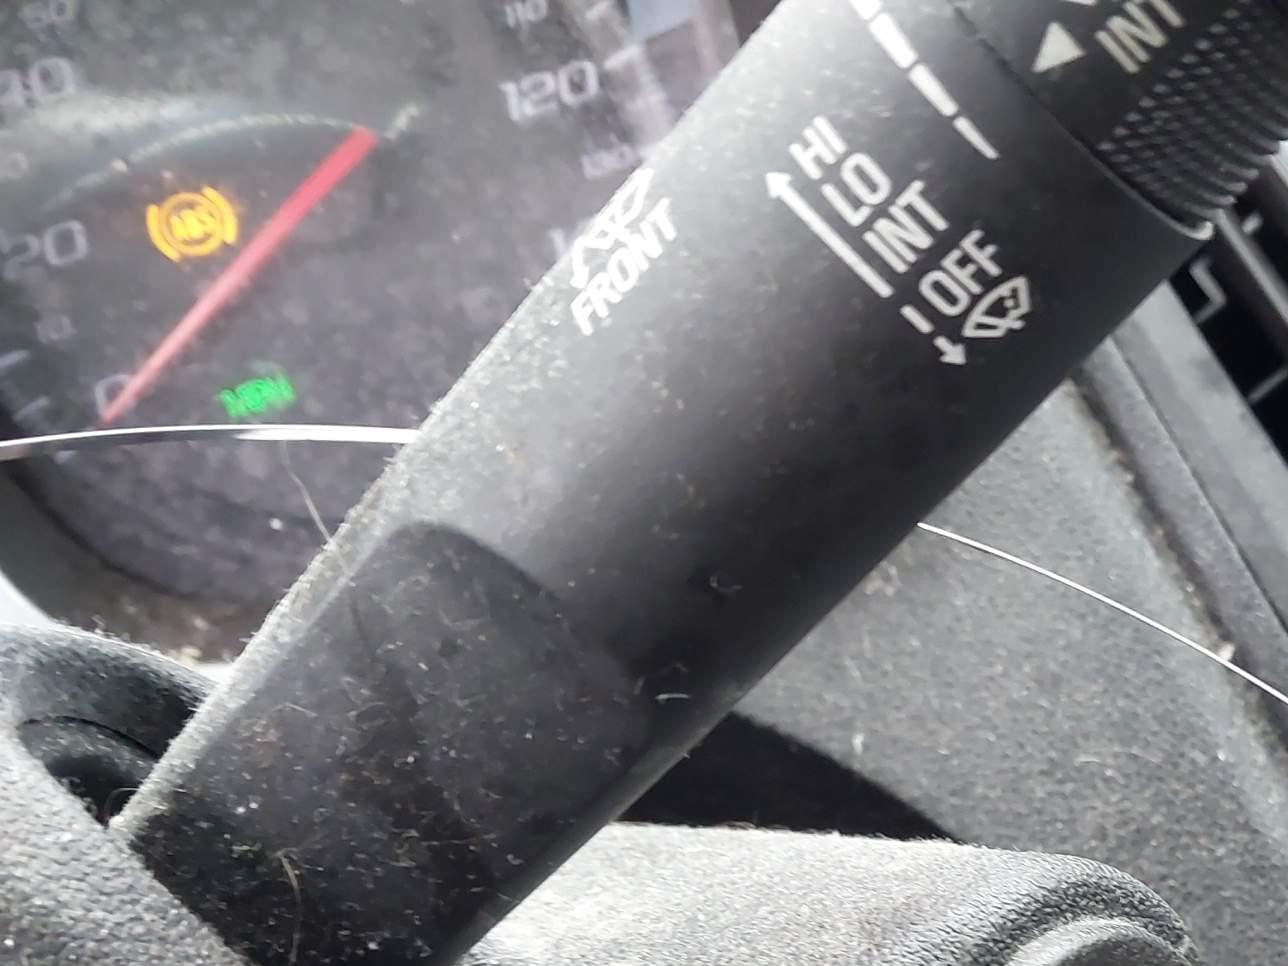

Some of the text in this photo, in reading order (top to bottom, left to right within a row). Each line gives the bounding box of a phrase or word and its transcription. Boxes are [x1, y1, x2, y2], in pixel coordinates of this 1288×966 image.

[500, 60, 600, 122] 120
[789, 115, 848, 180] HI
[820, 152, 893, 227] LO
[862, 180, 949, 274] INT
[2, 219, 89, 281] 20
[570, 197, 678, 337] FRONT
[918, 229, 1003, 317] OFF
